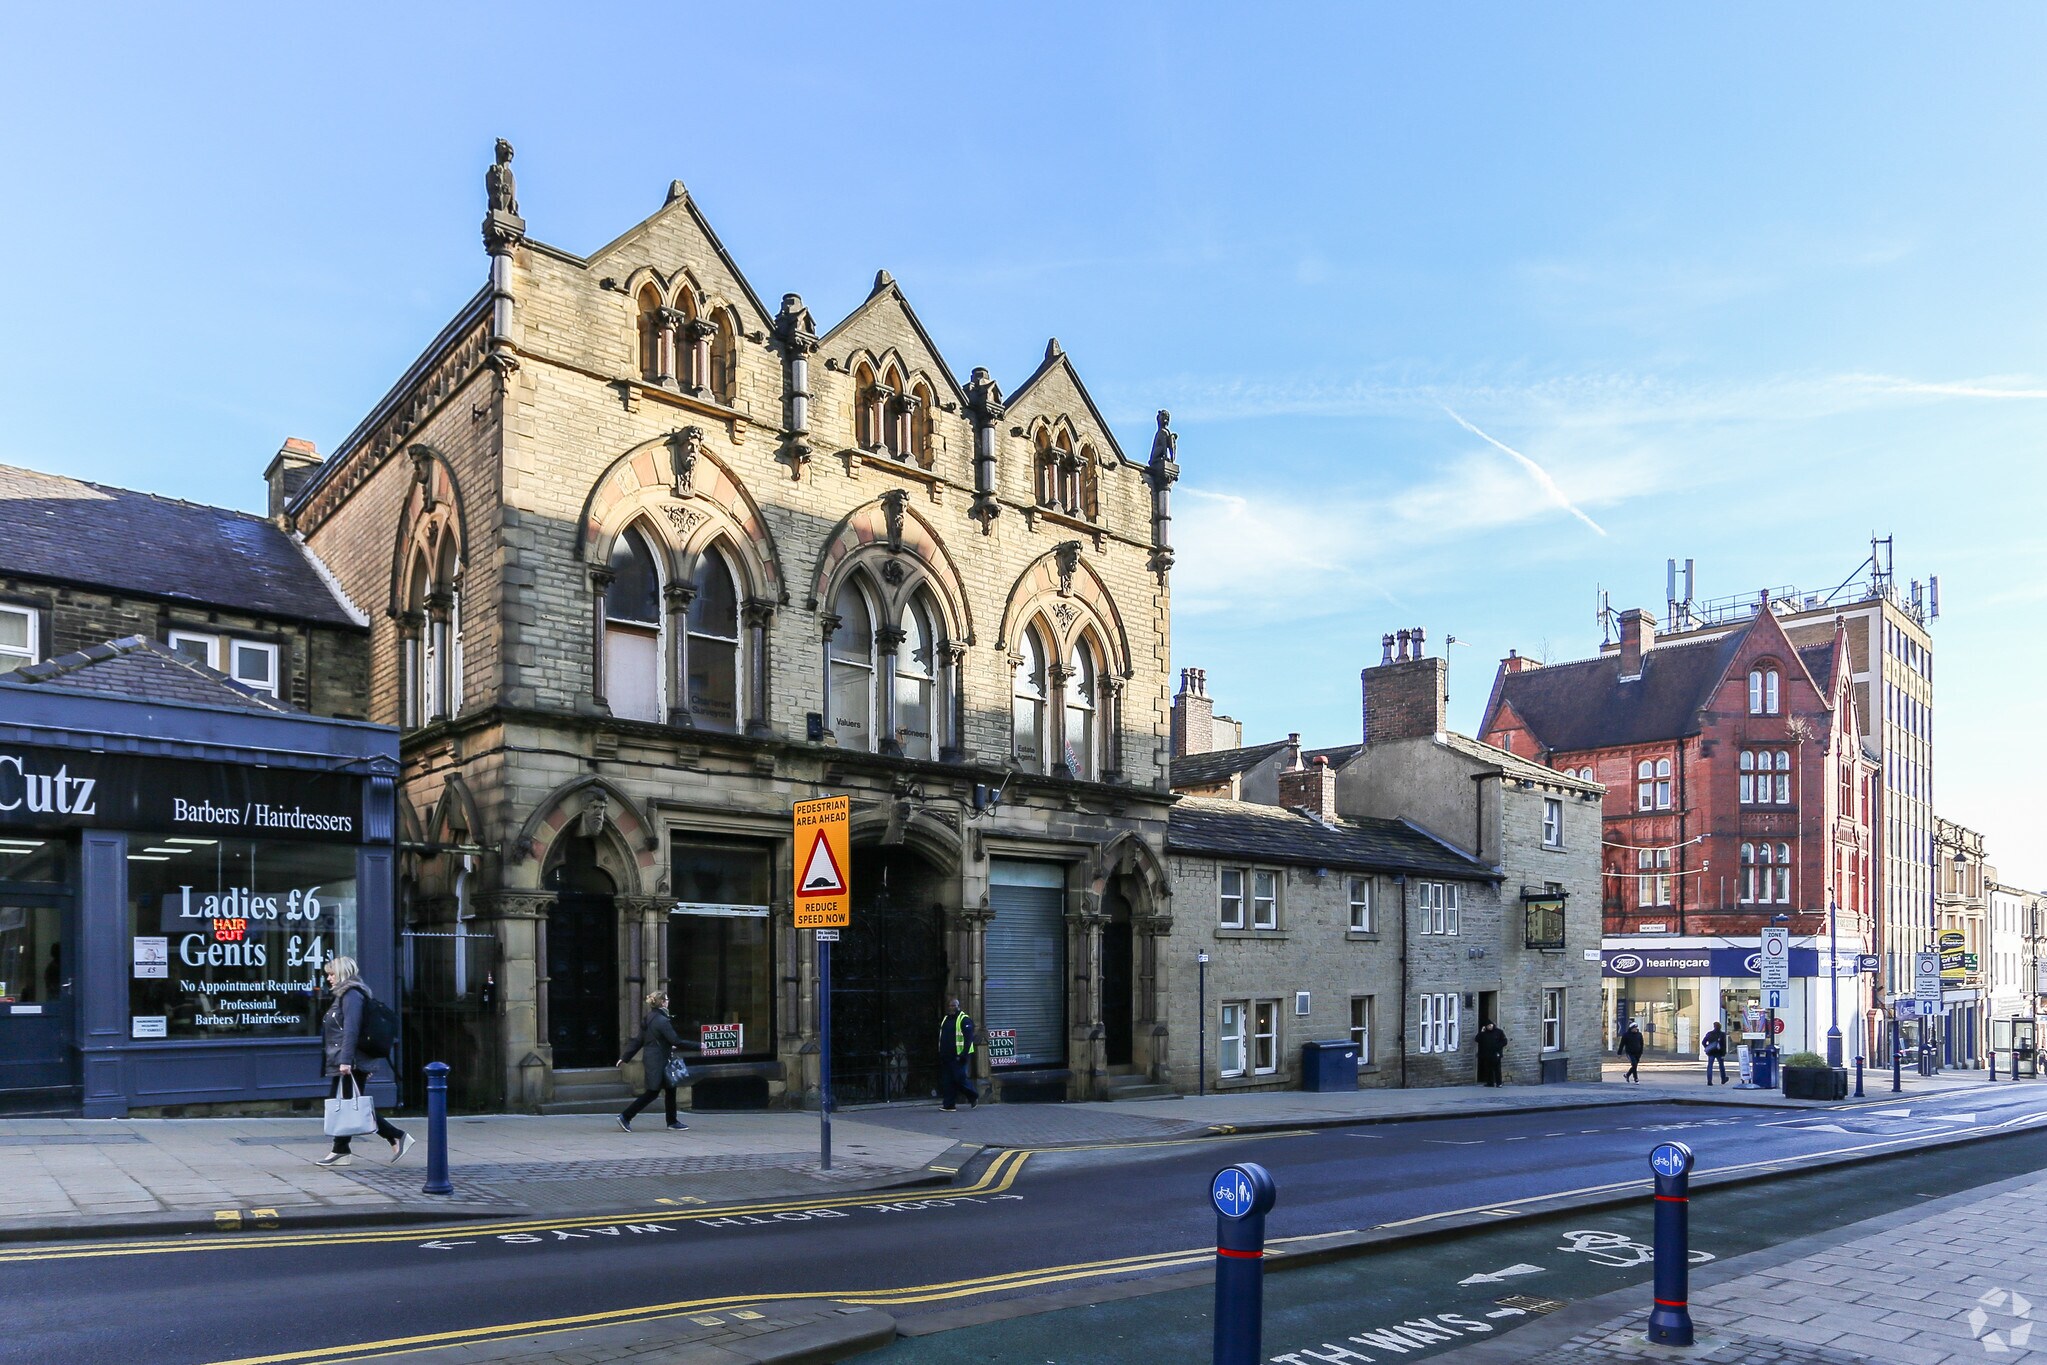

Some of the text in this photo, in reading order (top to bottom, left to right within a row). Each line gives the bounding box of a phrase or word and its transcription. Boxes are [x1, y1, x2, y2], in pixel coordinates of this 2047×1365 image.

[836, 717, 861, 728] Valuers
[1017, 744, 1035, 753] Estate
[1017, 752, 1036, 762] Agents
[0, 755, 97, 816] Cutz
[797, 800, 846, 815] PEDESTRIAN
[173, 798, 352, 832] Barbers / Hairdressers
[796, 811, 847, 827] AREA AHEAD
[179, 885, 322, 921] Ladies £6
[805, 902, 838, 912] REDUCE
[213, 918, 247, 931] HAIR
[798, 913, 846, 925] SPEED NOW
[215, 929, 245, 941] CUT
[180, 933, 267, 966] Gents
[1646, 958, 1710, 969] hearingcare
[180, 979, 314, 995] No Appointment Required
[220, 998, 277, 1011] Professional
[195, 1013, 234, 1026] Barbers
[241, 1013, 301, 1025] Hairdressers
[704, 1031, 737, 1040] BELTON
[704, 1040, 737, 1048] DUFFEY
[988, 1038, 1014, 1047] ELTON
[989, 1047, 1014, 1056] UFFEY
[496, 1197, 987, 1244] LOOK BOTH WAYS
[1348, 1313, 1494, 1354] WAYS
